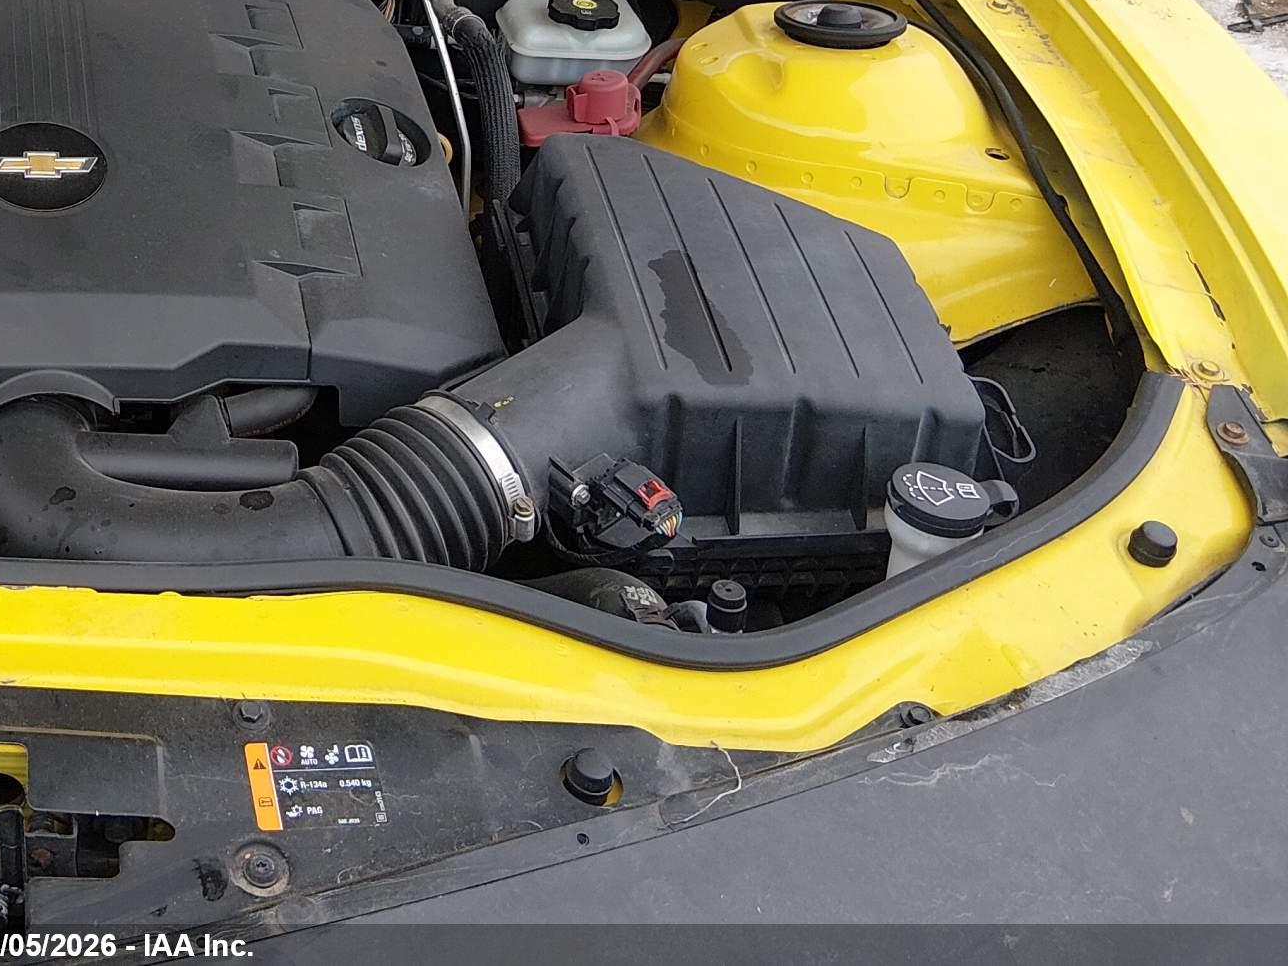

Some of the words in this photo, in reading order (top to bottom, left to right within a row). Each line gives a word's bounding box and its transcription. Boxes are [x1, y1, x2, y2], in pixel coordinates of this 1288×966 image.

[351, 115, 368, 152] dexos
[361, 779, 372, 789] kg
[307, 806, 323, 815] PAG
